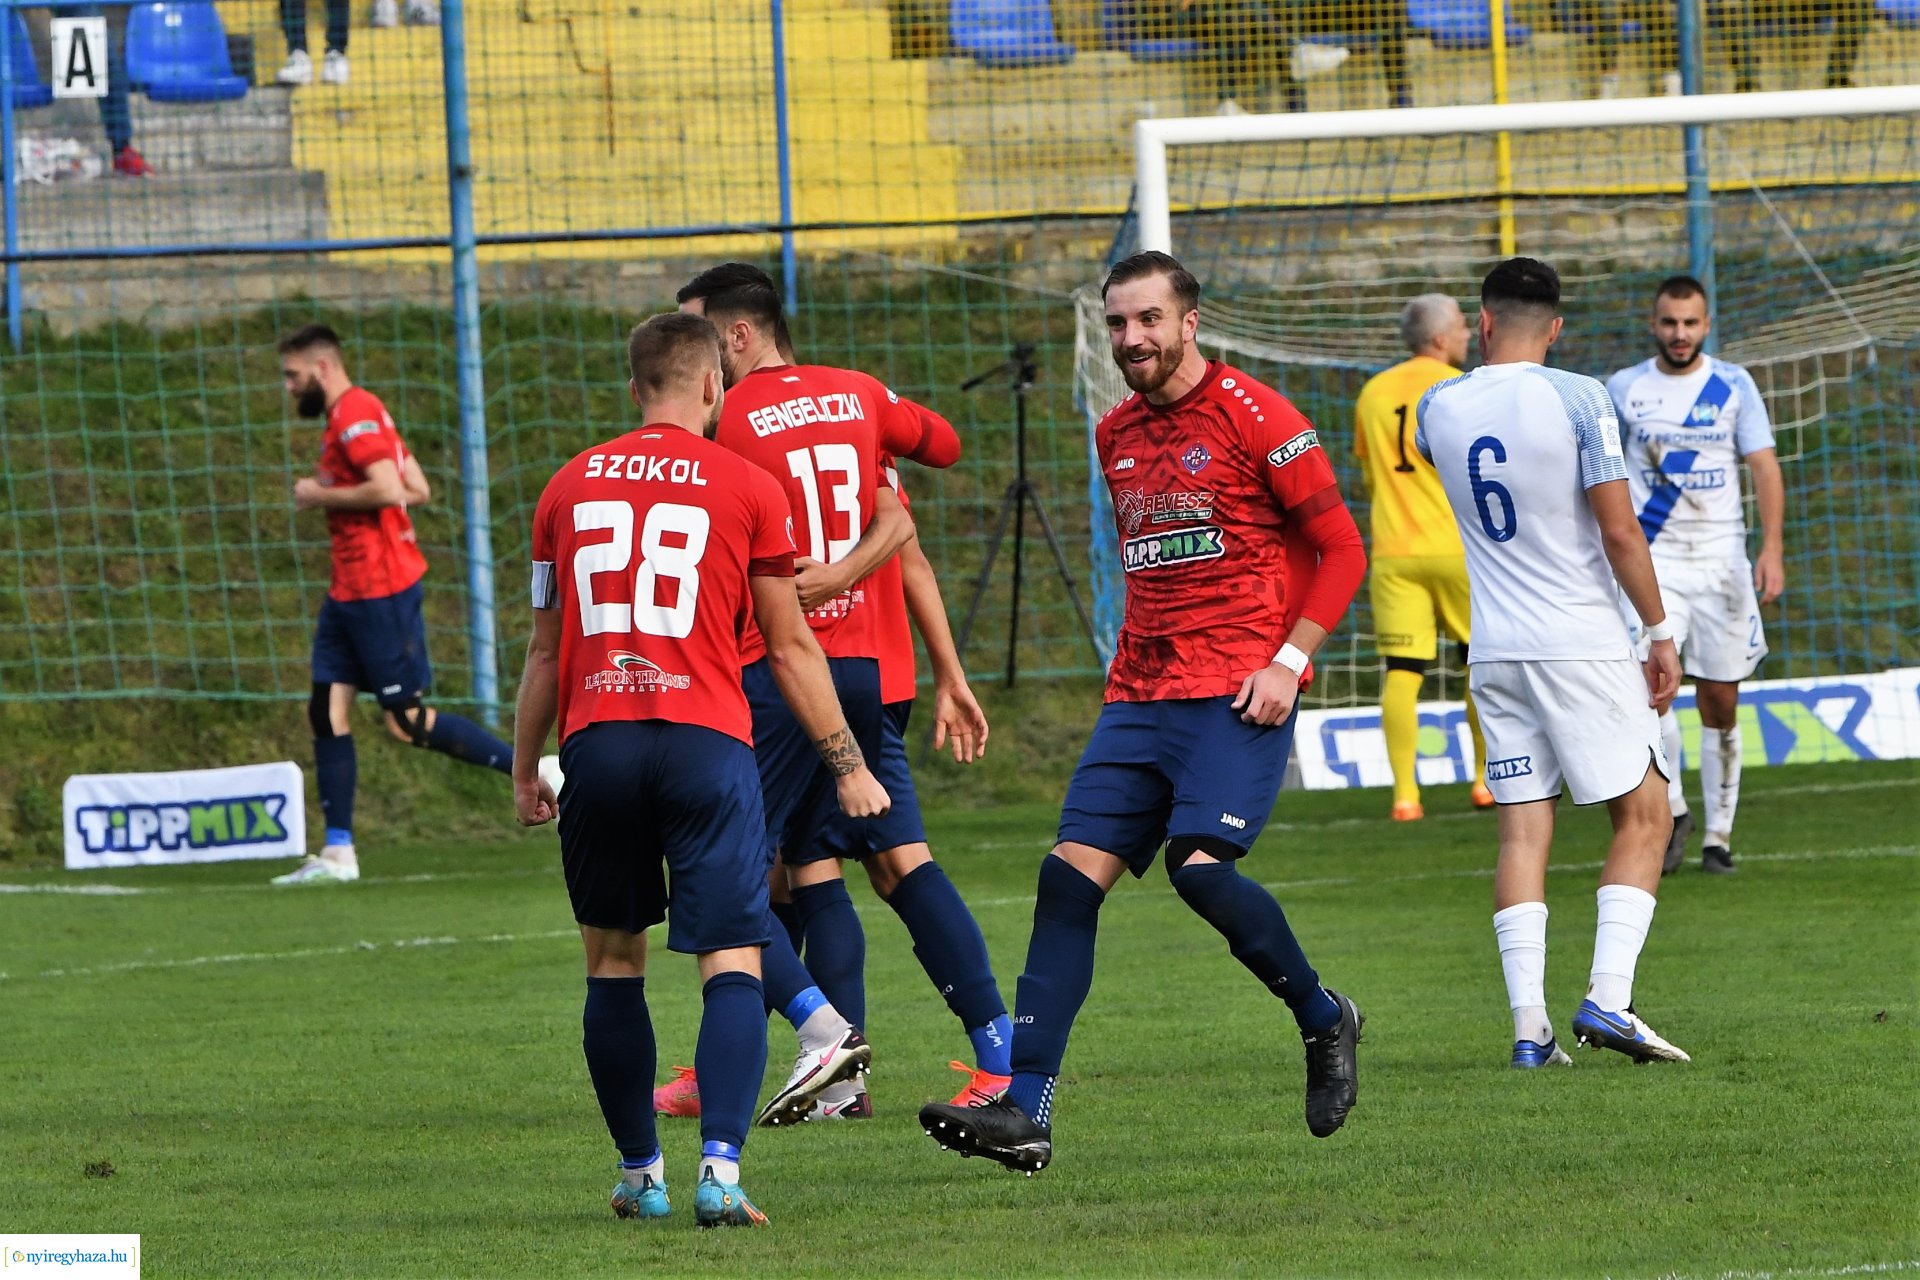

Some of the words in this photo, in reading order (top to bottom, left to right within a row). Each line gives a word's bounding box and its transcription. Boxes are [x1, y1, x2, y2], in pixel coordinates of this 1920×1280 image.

[66, 27, 95, 88] A
[747, 393, 865, 438] GENGELICZKI
[1394, 404, 1415, 472] 1
[585, 454, 708, 486] SZOKOL
[1115, 458, 1134, 470] JAKO
[786, 443, 861, 564] 13
[1468, 435, 1517, 542] 6
[573, 500, 710, 639] 28
[1749, 615, 1759, 647] 2
[635, 670, 690, 689] TRANS
[1220, 813, 1246, 829] JAKO
